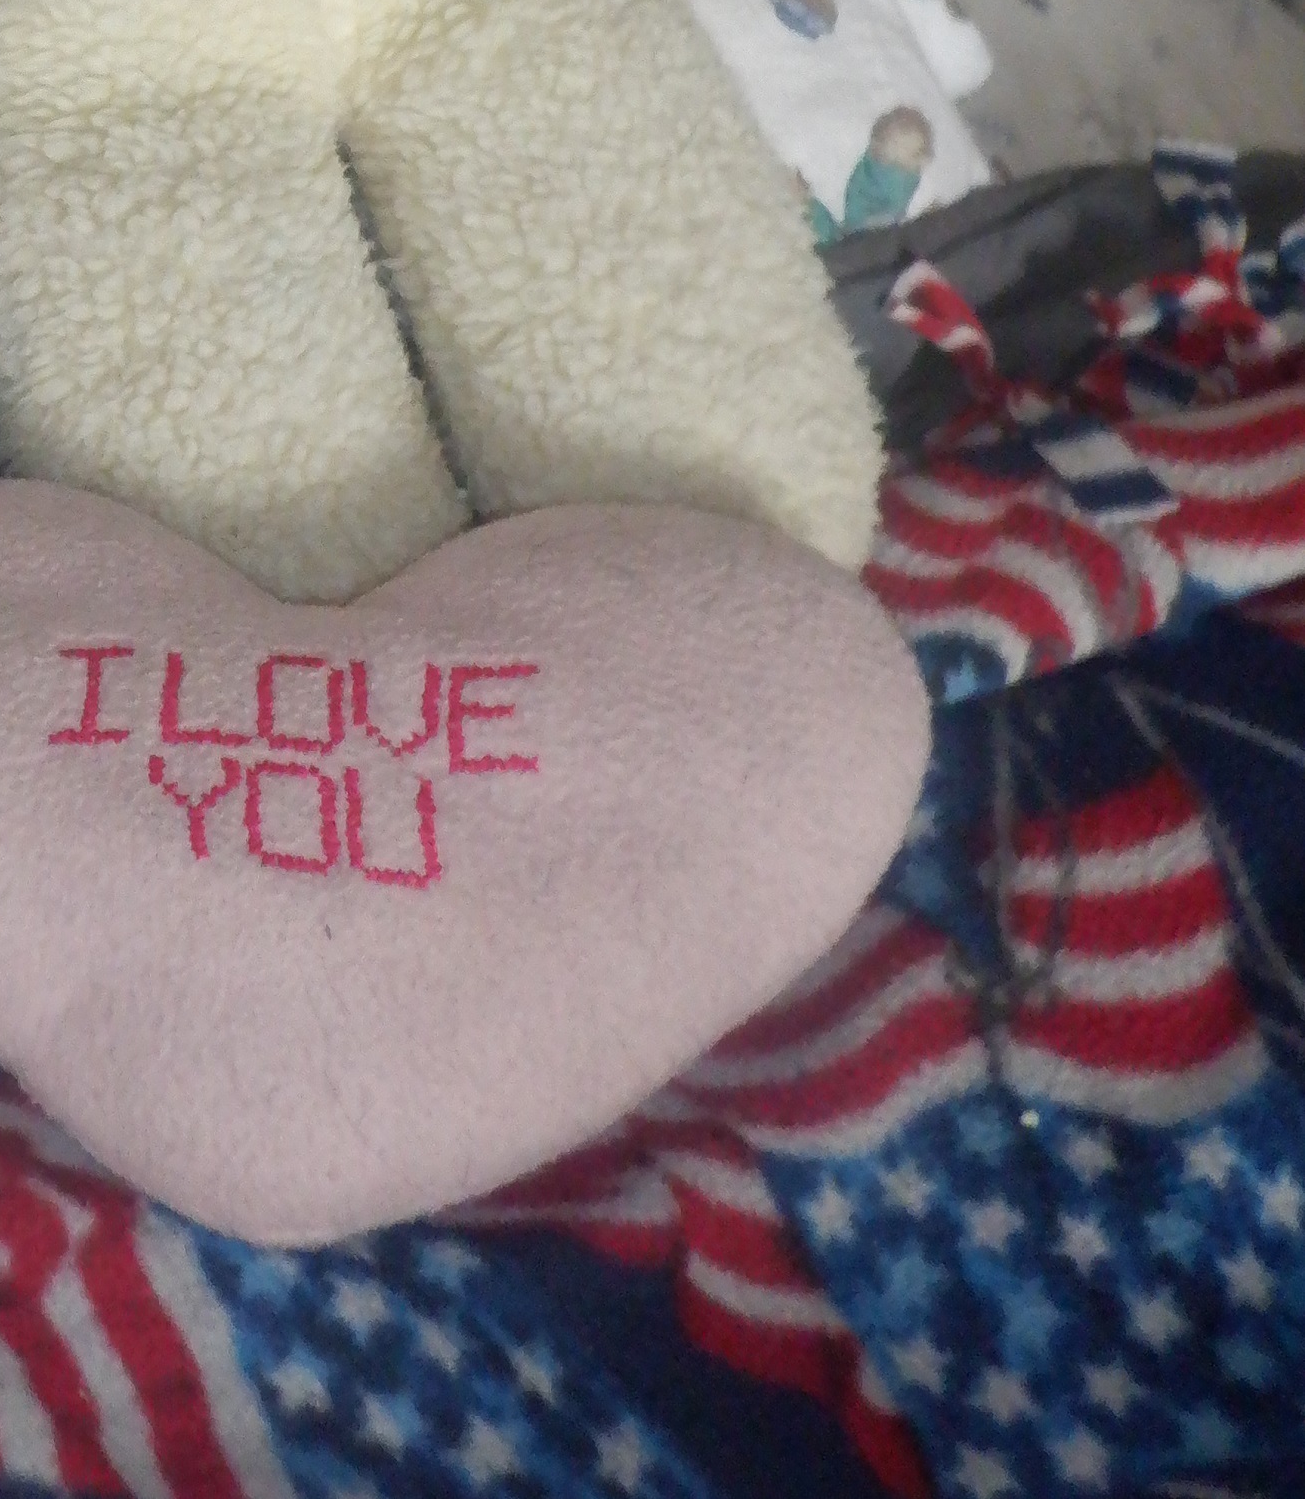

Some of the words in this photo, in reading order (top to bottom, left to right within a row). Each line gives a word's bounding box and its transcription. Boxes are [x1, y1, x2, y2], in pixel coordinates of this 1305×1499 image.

[48, 644, 134, 746] I
[159, 651, 539, 774] LOVE
[147, 754, 442, 890] YOU
